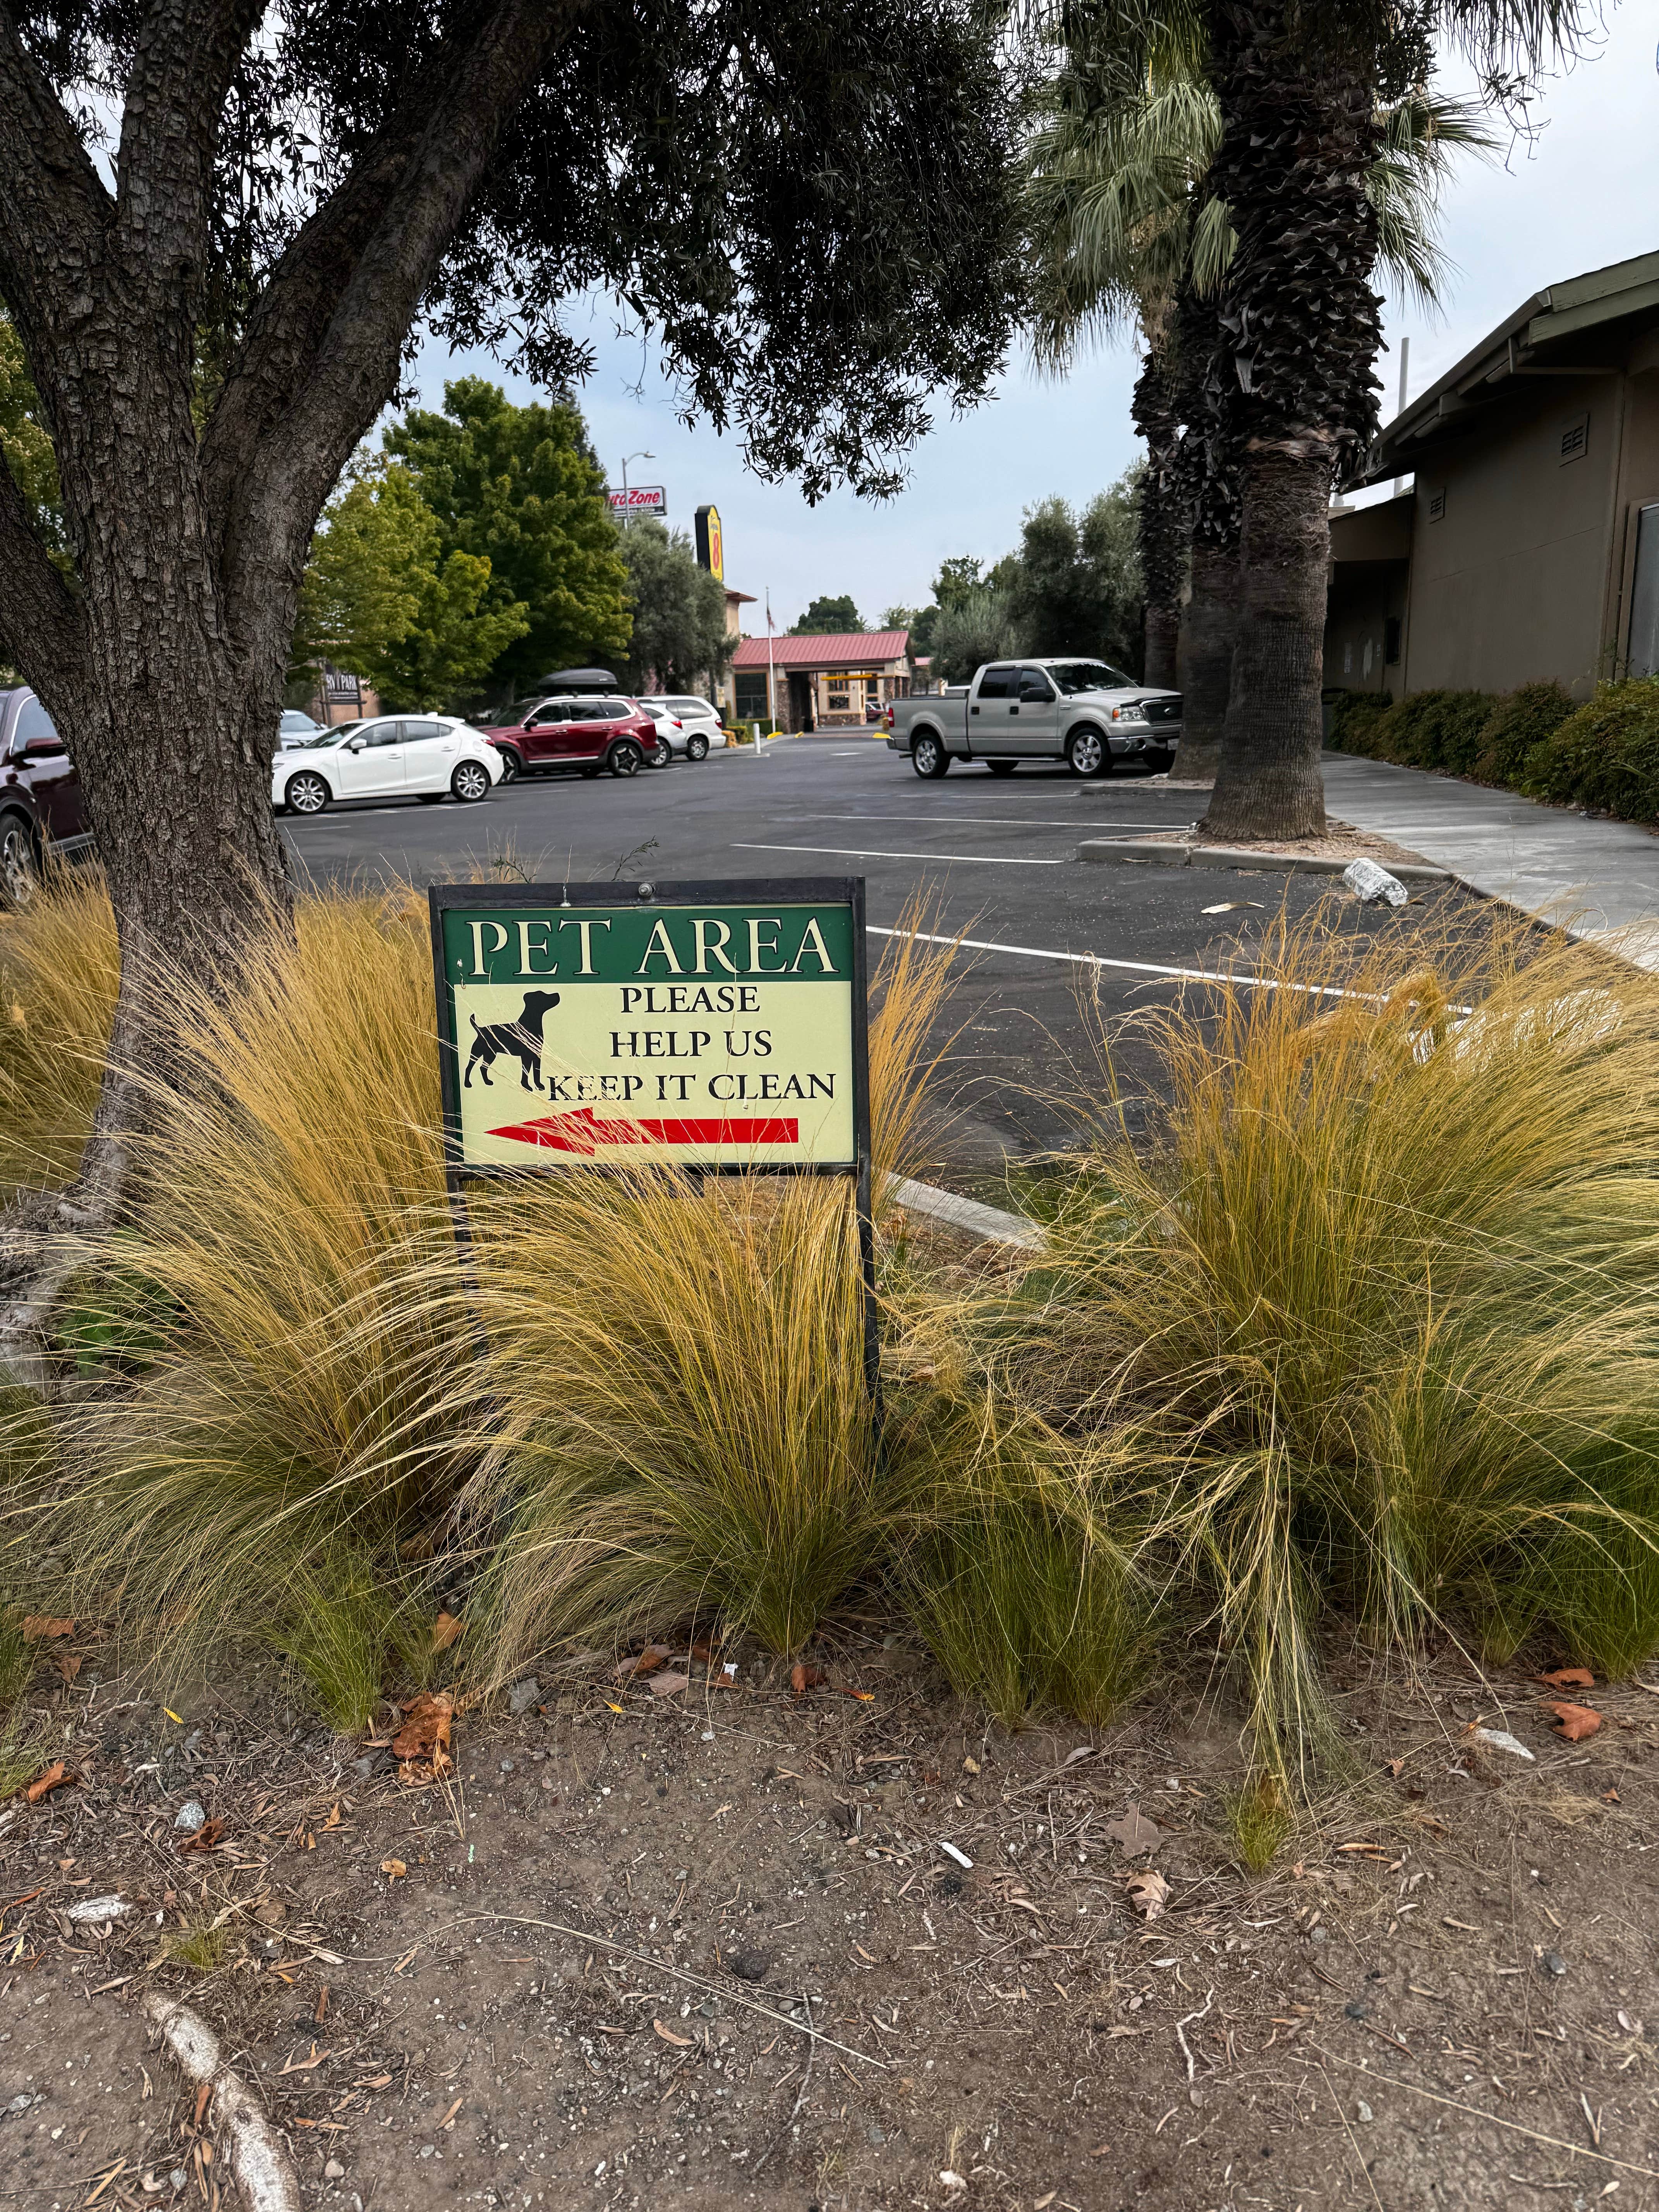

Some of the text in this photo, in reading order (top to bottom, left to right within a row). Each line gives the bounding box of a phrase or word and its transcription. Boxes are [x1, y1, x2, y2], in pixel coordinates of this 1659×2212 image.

[607, 490, 660, 505] utoZone
[341, 674, 358, 690] PARK
[466, 916, 840, 976] PET AREA
[620, 986, 761, 1013] PLEASE
[610, 1030, 772, 1058] HELP US
[547, 1073, 836, 1101] KEEP IT CLEAN
